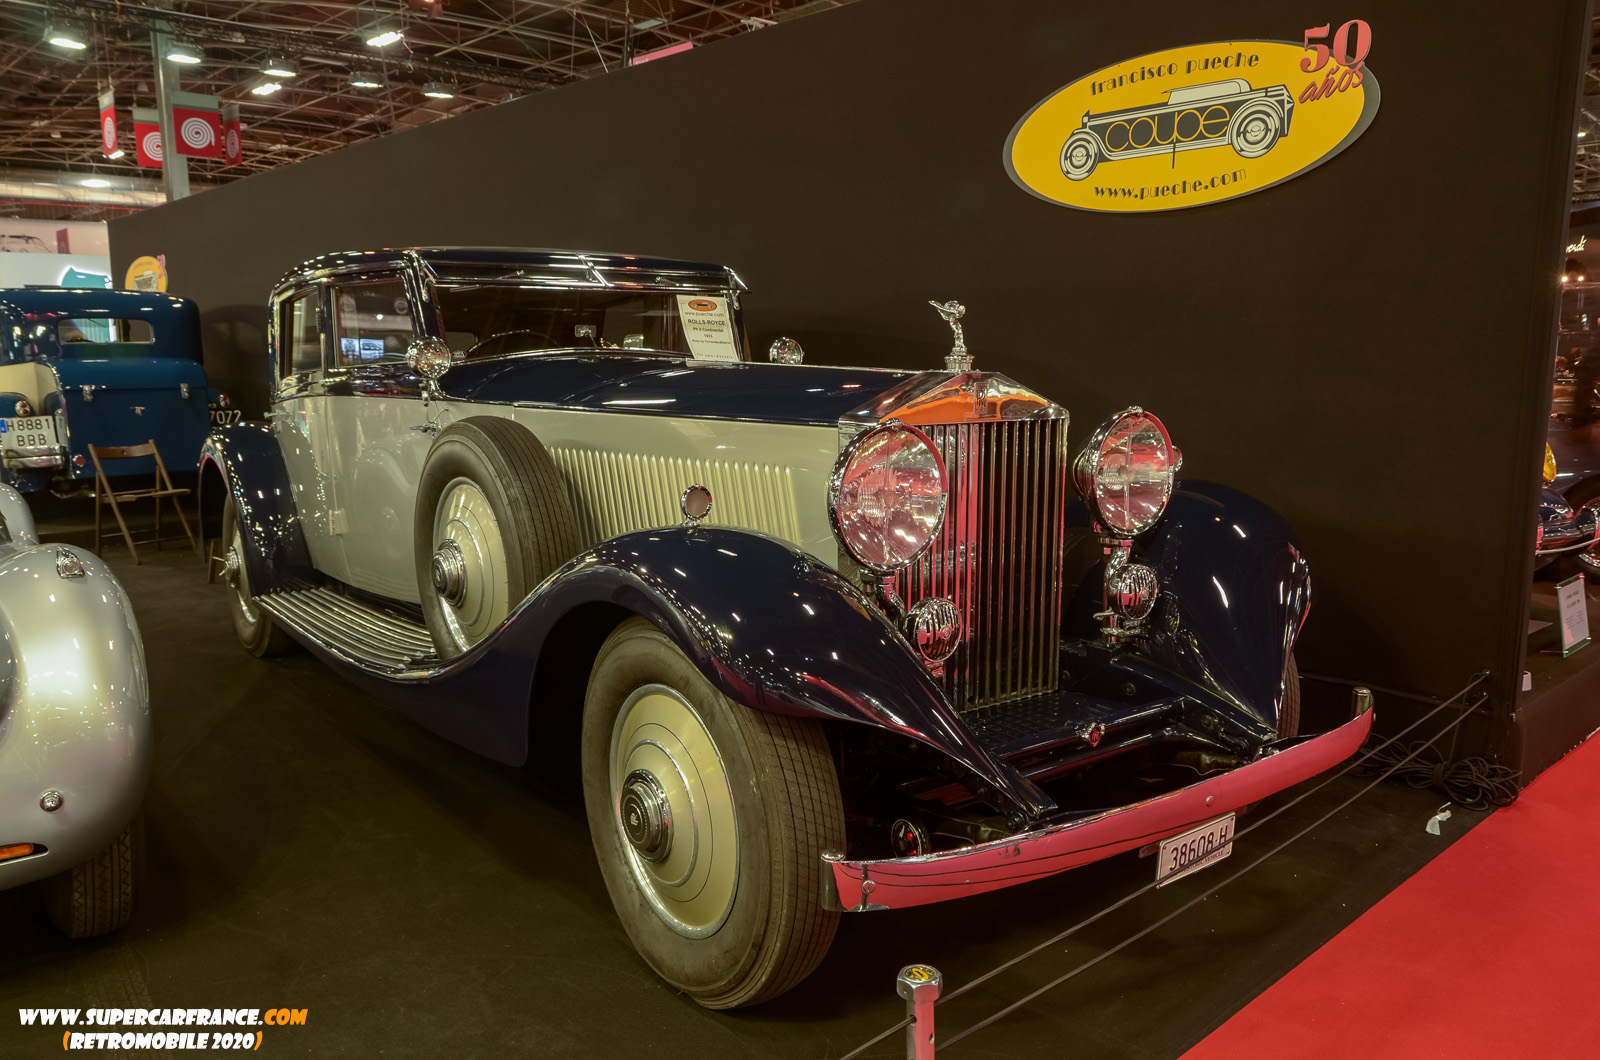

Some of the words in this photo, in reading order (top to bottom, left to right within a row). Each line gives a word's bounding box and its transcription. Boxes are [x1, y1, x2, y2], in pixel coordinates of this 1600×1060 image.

[1300, 19, 1372, 72] 50
[1090, 61, 1178, 95] francisco
[1186, 52, 1259, 75] pueche
[1298, 60, 1365, 104] años
[1105, 105, 1230, 166] coupe
[1093, 168, 1247, 200] www.pueche.com
[16, 434, 47, 447] BBB
